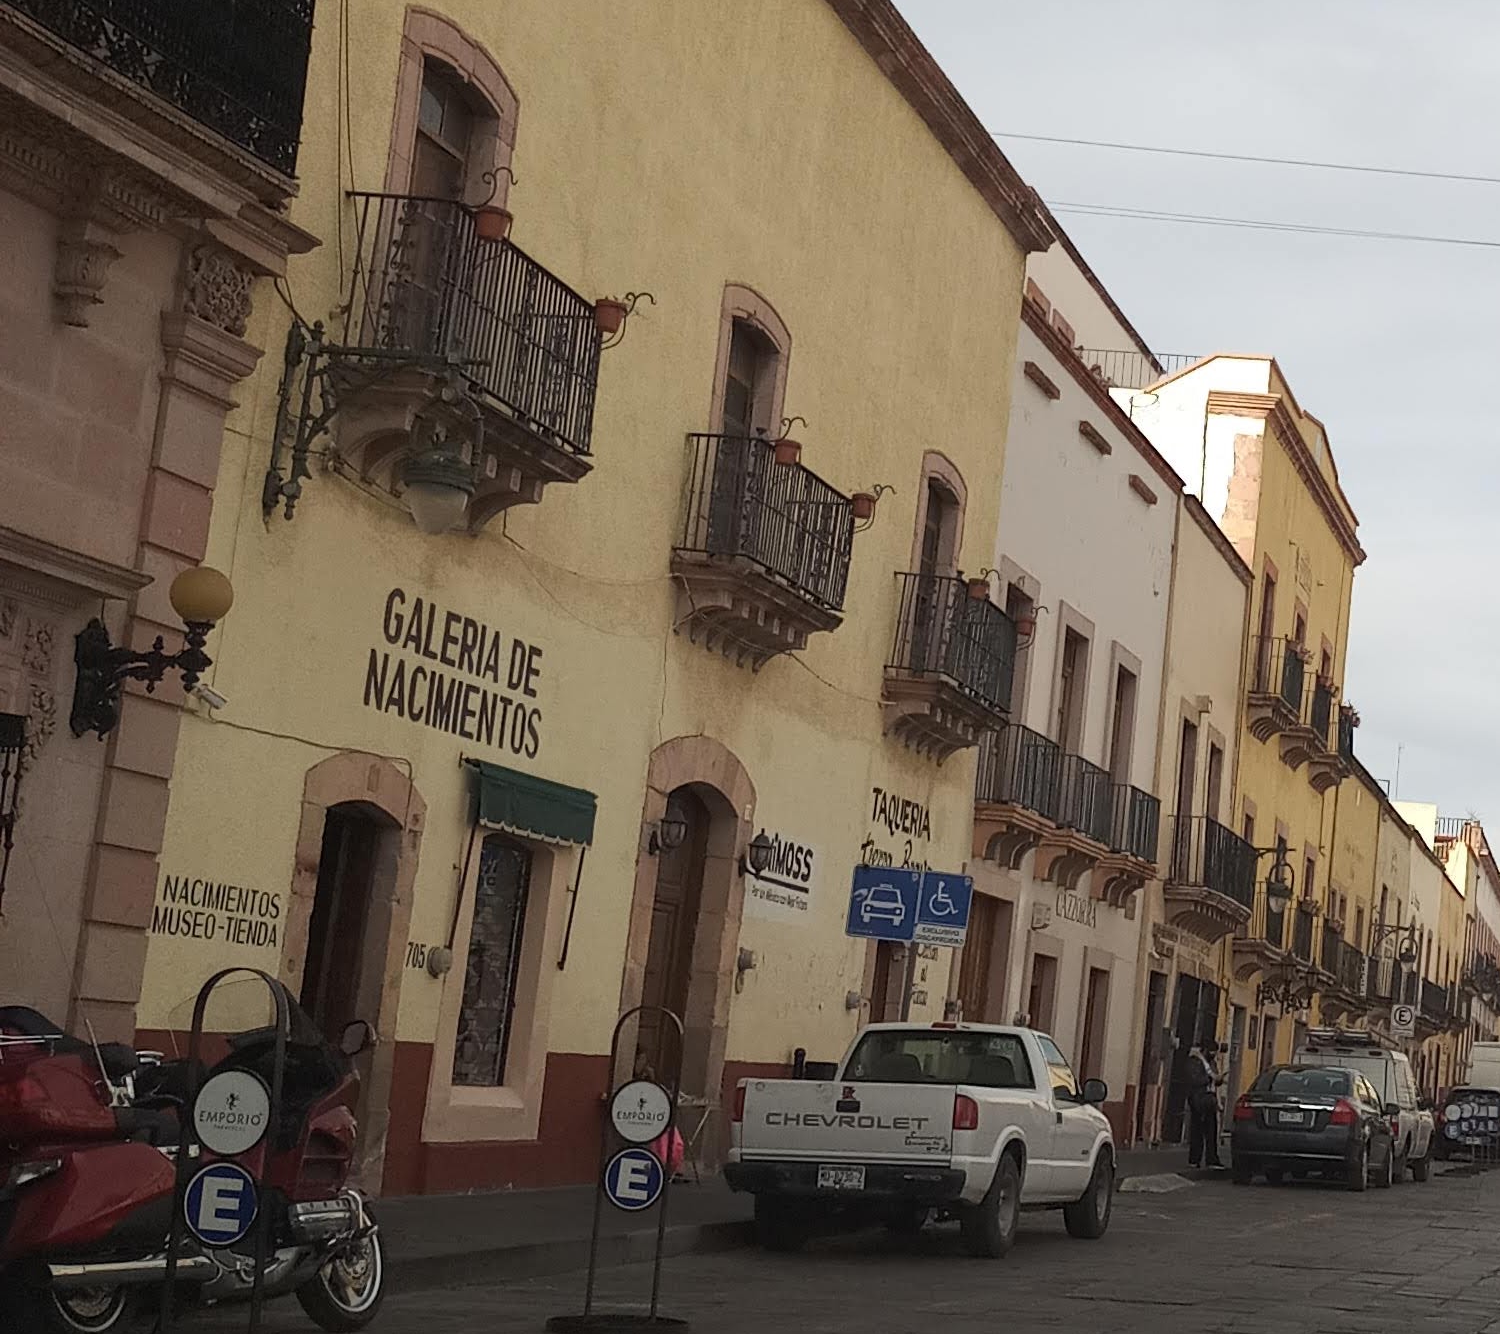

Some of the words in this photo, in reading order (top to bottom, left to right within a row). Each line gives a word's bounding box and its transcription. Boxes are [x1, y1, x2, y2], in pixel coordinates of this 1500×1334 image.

[383, 587, 501, 684] GALERIA
[507, 638, 543, 699] DE
[363, 648, 542, 760] NACIMIENTOS
[872, 787, 931, 842] TAQUERIA
[162, 874, 280, 920] NACIMIENTOS
[151, 905, 277, 947] MUSEO-TIENDA
[405, 941, 427, 969] 705
[1398, 1009, 1408, 1023] E
[199, 1110, 261, 1127] EMPORIO
[616, 1110, 665, 1122] EMPORIO
[765, 1112, 929, 1131] CHEVROLET
[615, 1157, 652, 1201] E
[198, 1175, 244, 1233] E
